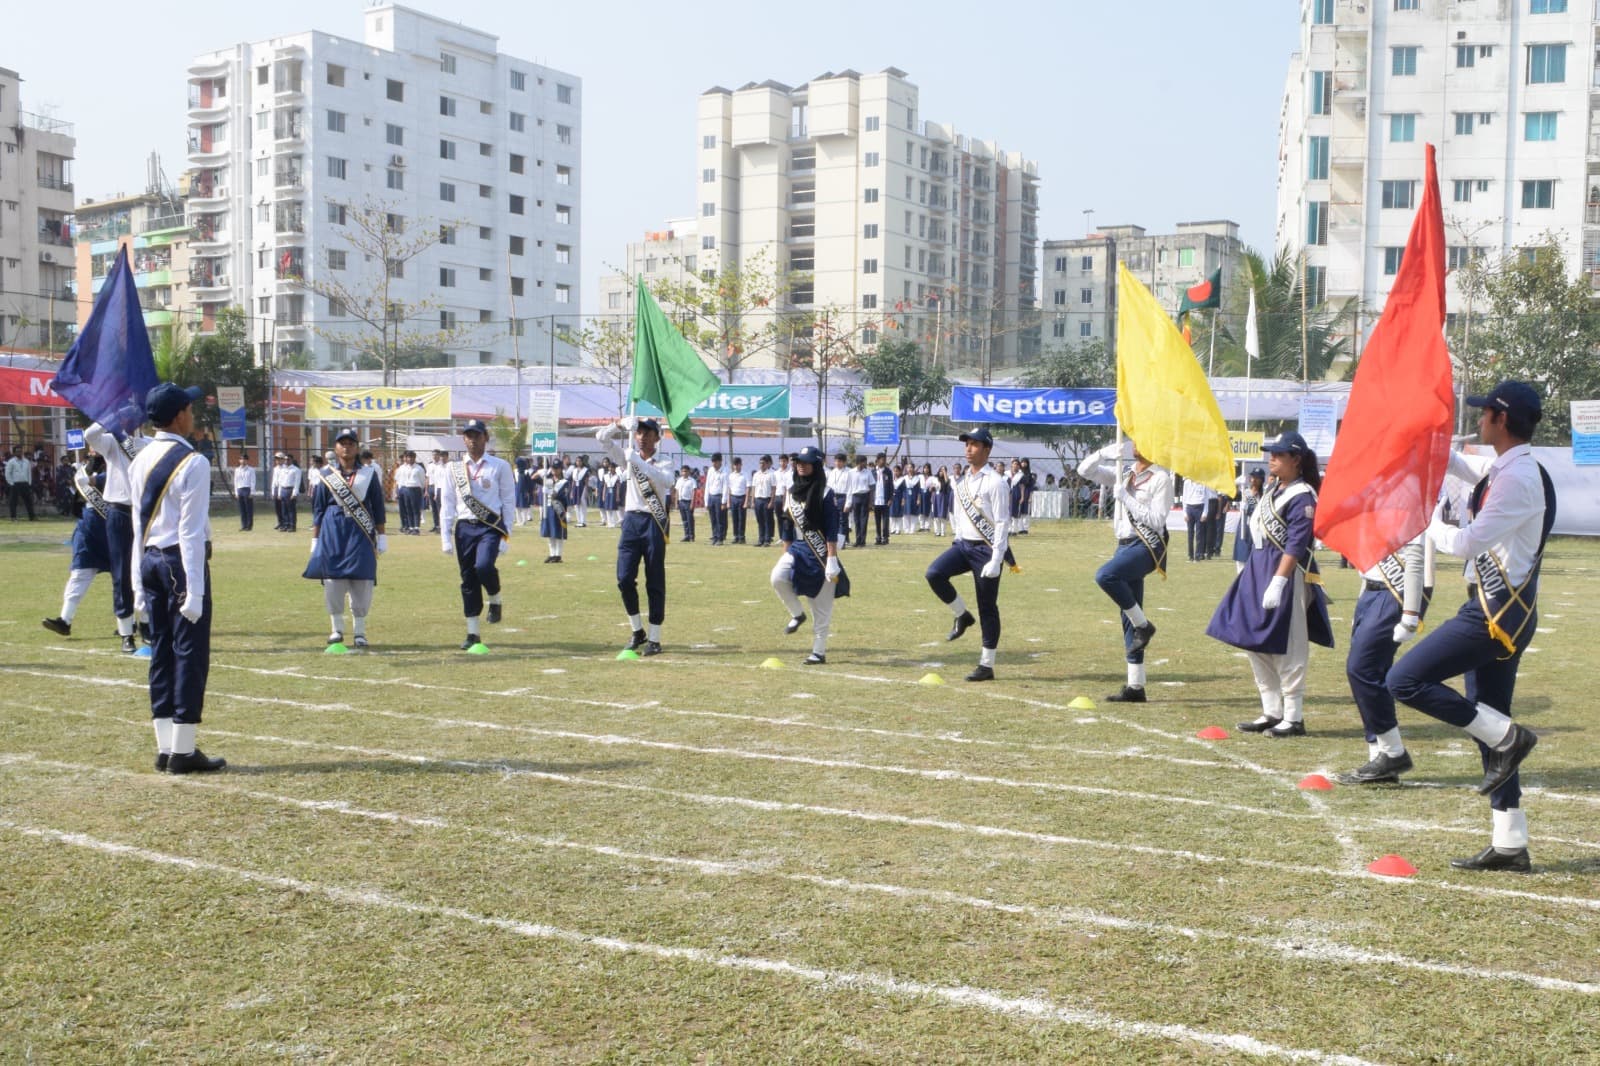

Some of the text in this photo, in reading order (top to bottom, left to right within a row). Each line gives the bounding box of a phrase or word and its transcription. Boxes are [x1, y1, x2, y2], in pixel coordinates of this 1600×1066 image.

[330, 395, 425, 410] Saturn
[972, 393, 1106, 418] Neptune
[534, 437, 555, 450] Jupiter
[1475, 550, 1506, 600] CHOOL
